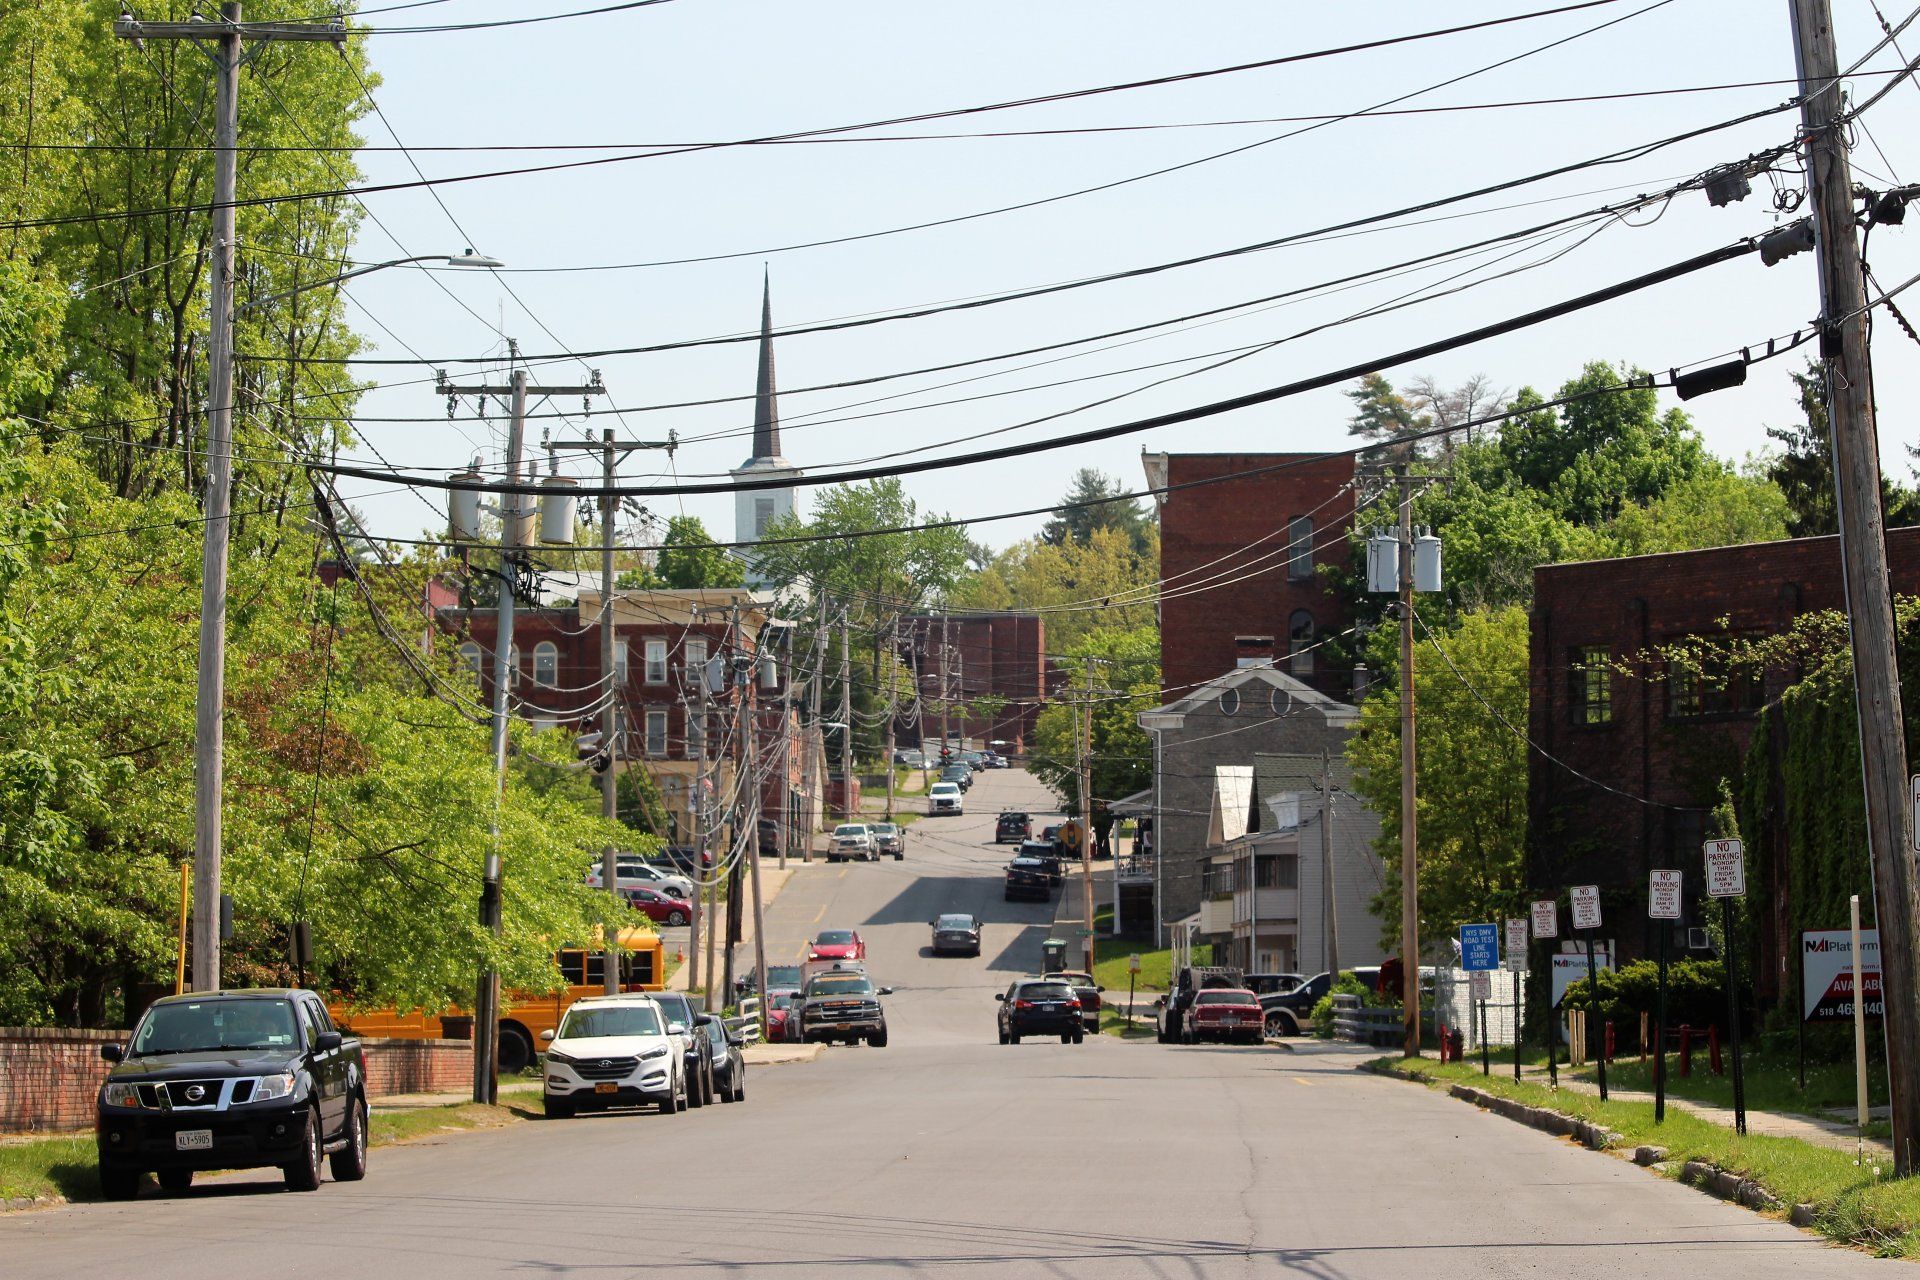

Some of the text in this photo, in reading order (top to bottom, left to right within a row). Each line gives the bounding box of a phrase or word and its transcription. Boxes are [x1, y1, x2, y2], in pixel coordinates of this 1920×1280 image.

[1716, 842, 1730, 852] NO
[1708, 852, 1740, 861] PARKING
[1660, 872, 1671, 881] NO
[1579, 888, 1590, 896] NO
[1465, 929, 1492, 937] NYS DMV
[1463, 936, 1495, 945] ROAD TEST
[1470, 952, 1490, 960] STARTS
[1819, 1008, 1834, 1016] 518
